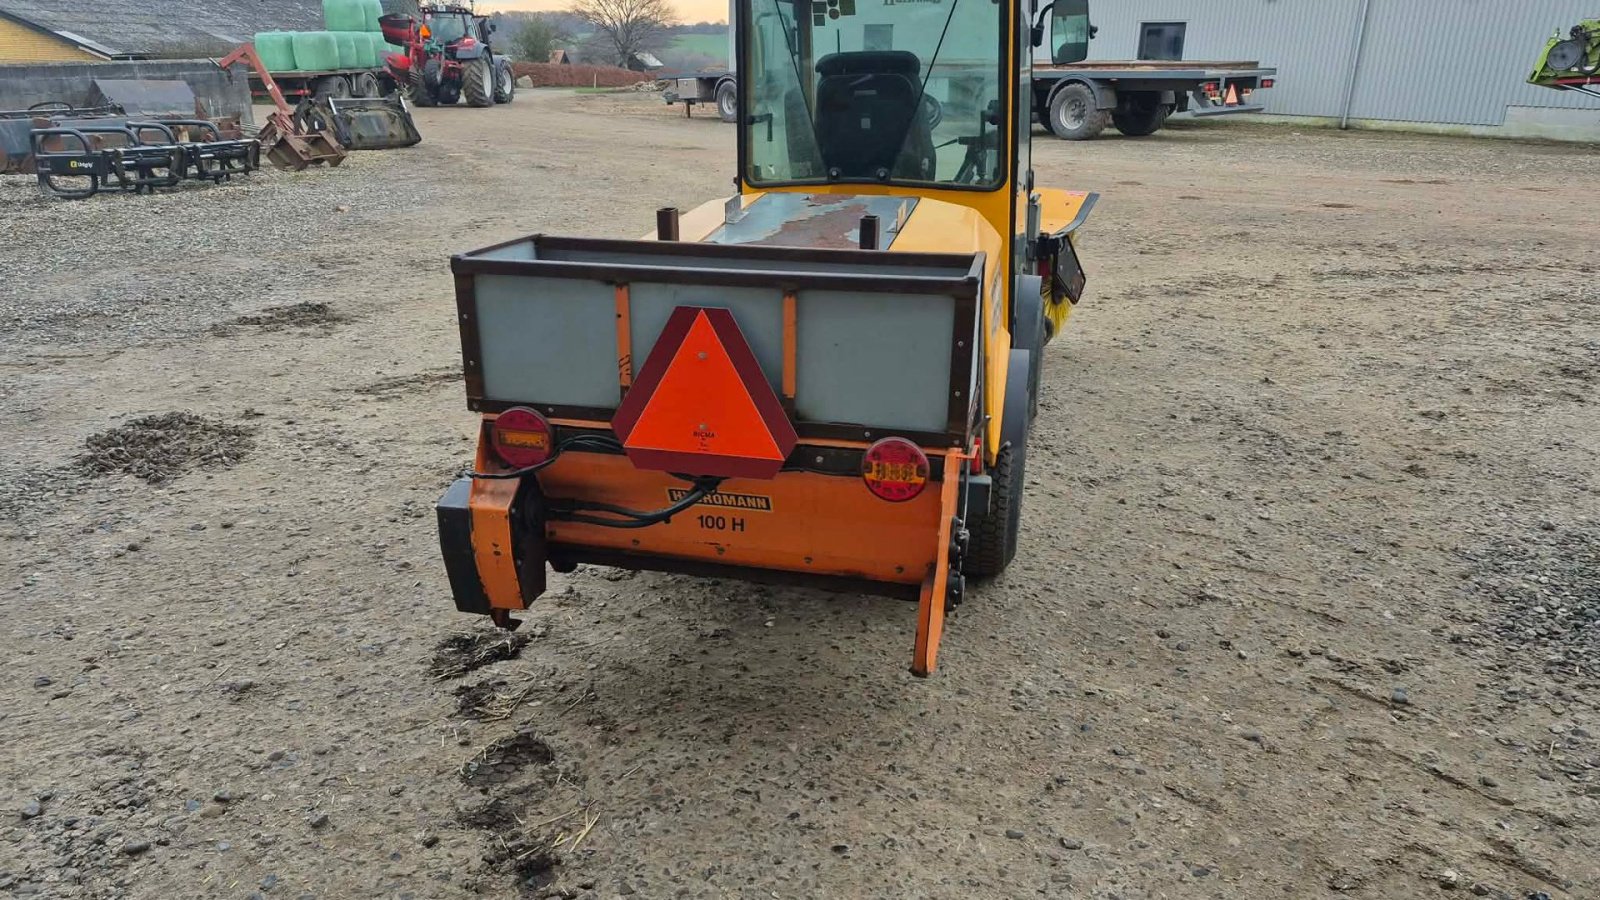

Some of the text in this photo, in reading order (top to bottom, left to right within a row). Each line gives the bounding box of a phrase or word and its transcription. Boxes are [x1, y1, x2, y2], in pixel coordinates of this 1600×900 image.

[672, 490, 767, 509] HROMANN
[697, 515, 745, 532] 100 H
